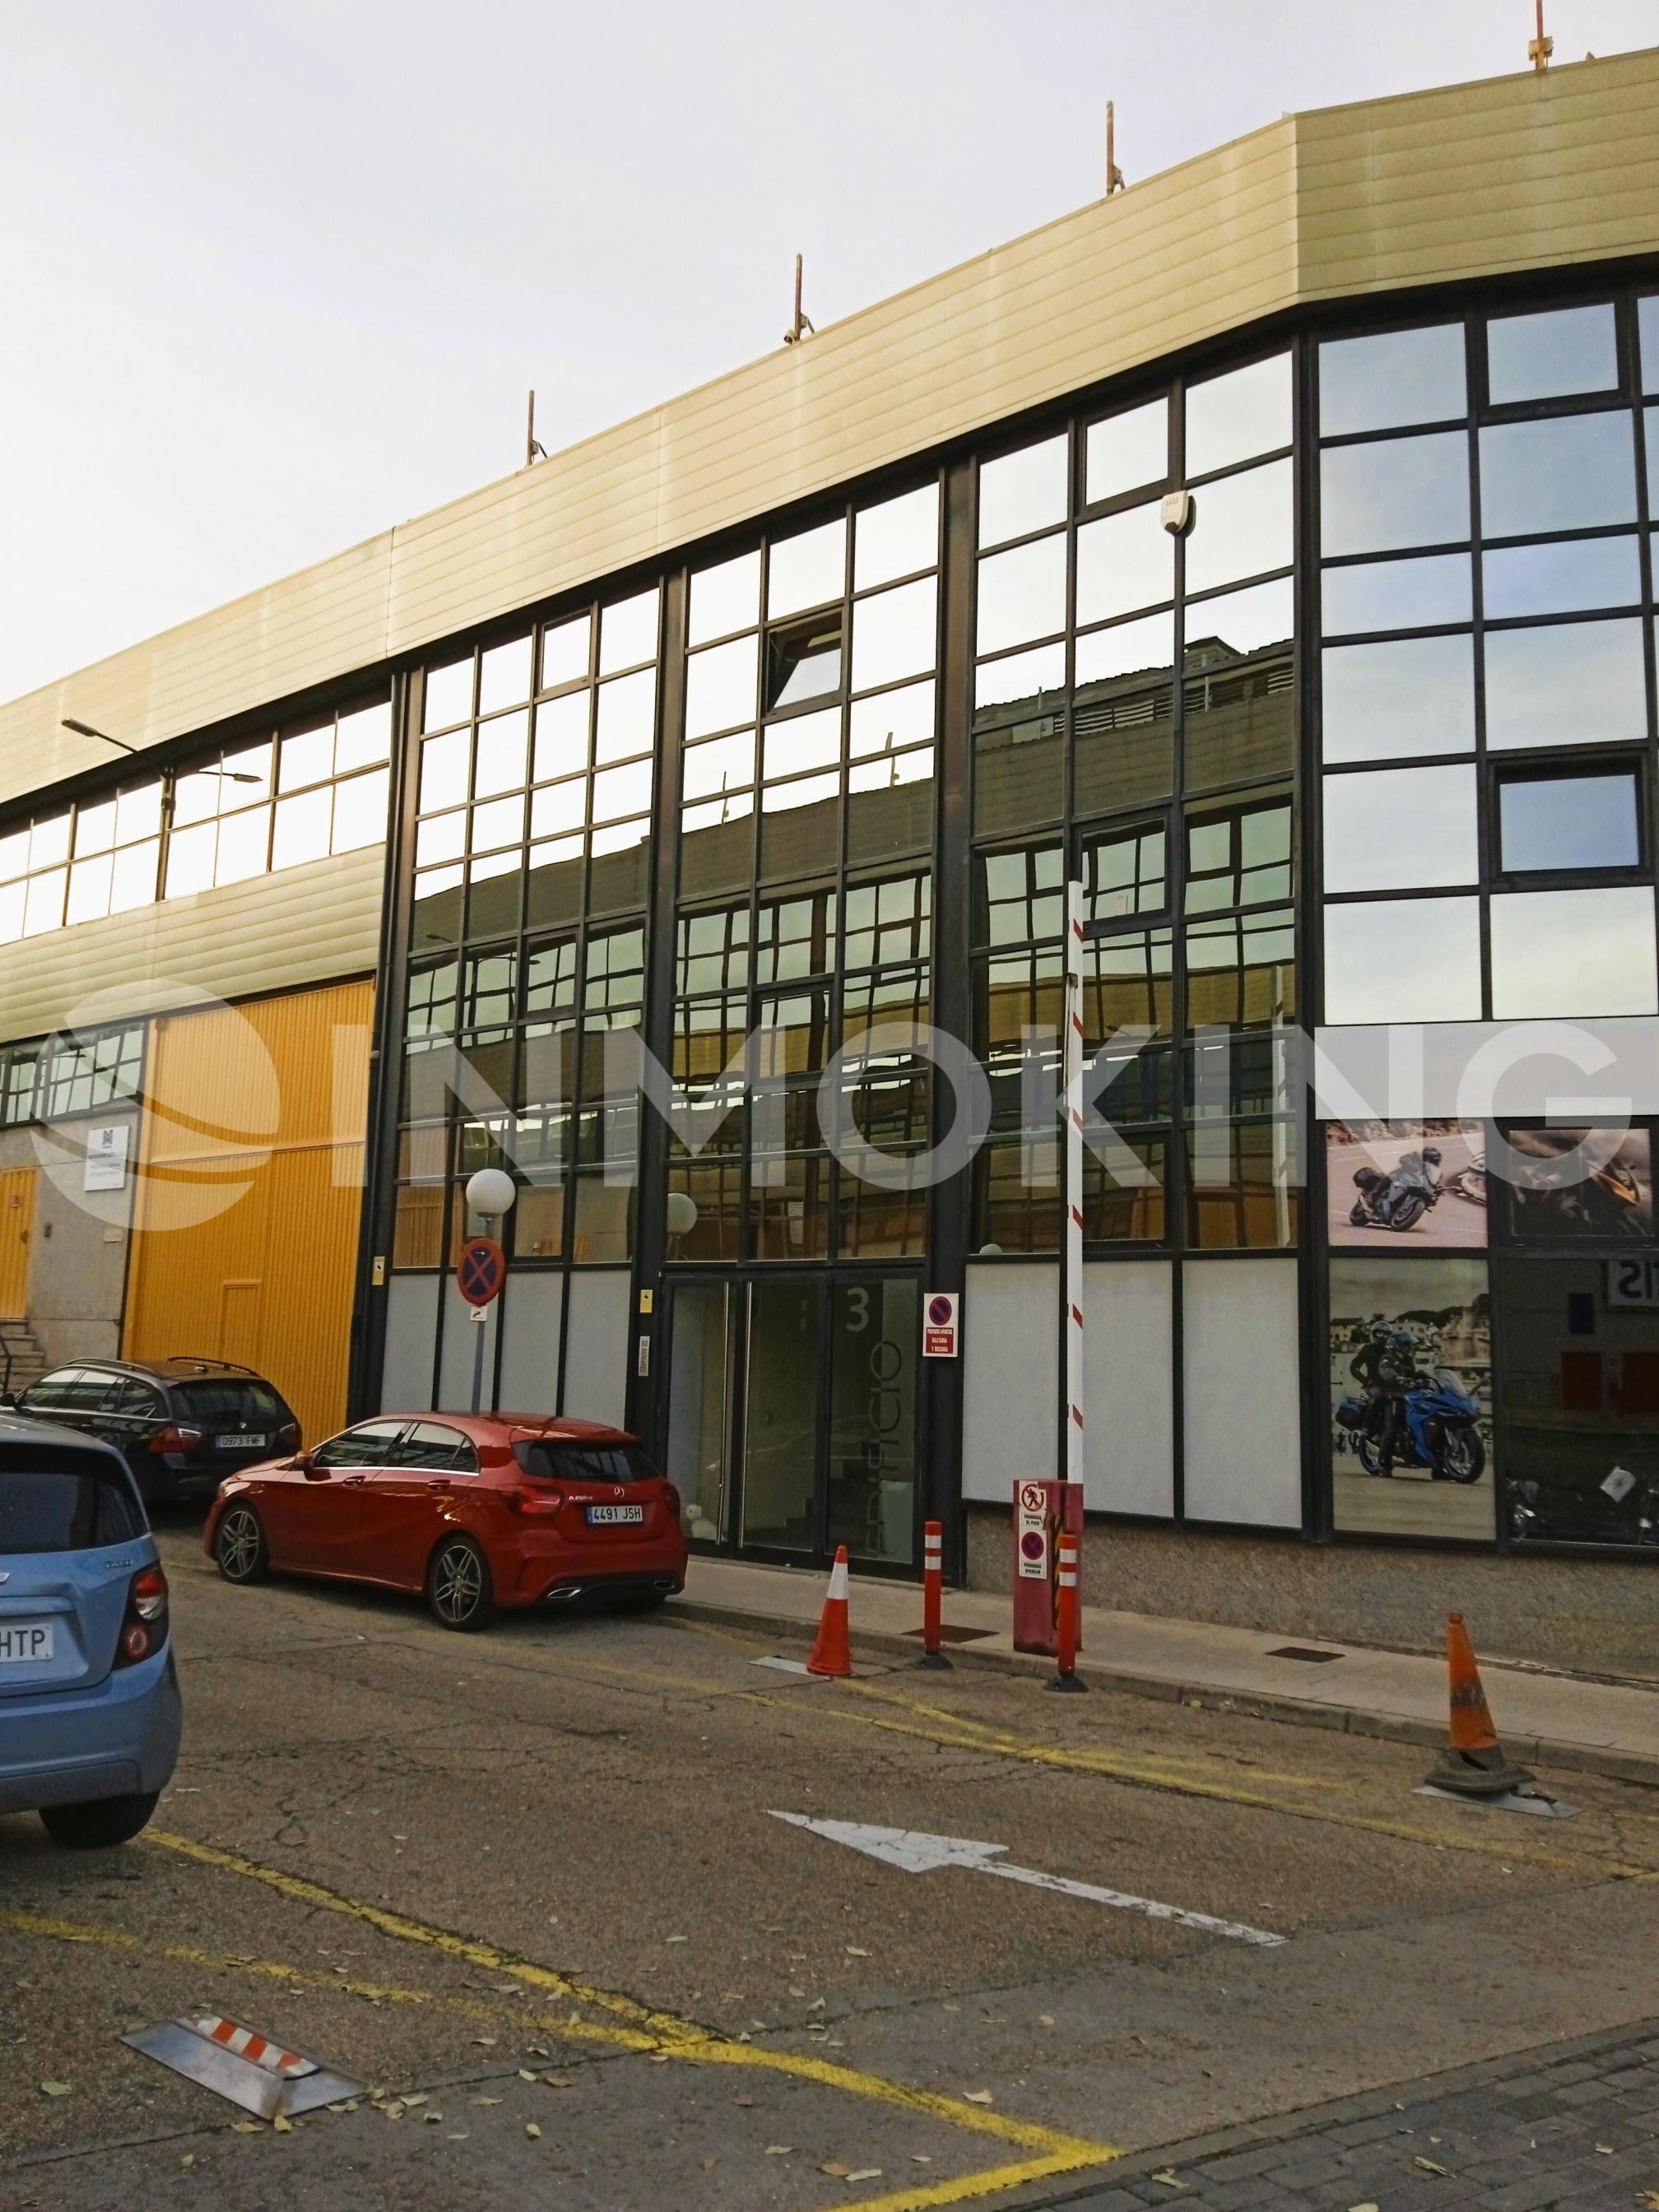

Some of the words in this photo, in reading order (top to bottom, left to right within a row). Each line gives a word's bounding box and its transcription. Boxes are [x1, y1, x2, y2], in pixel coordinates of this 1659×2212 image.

[845, 1286, 870, 1333] 3
[594, 1508, 618, 1521] 4491
[623, 1508, 641, 1519] JSH
[0, 1629, 45, 1657] HTP
